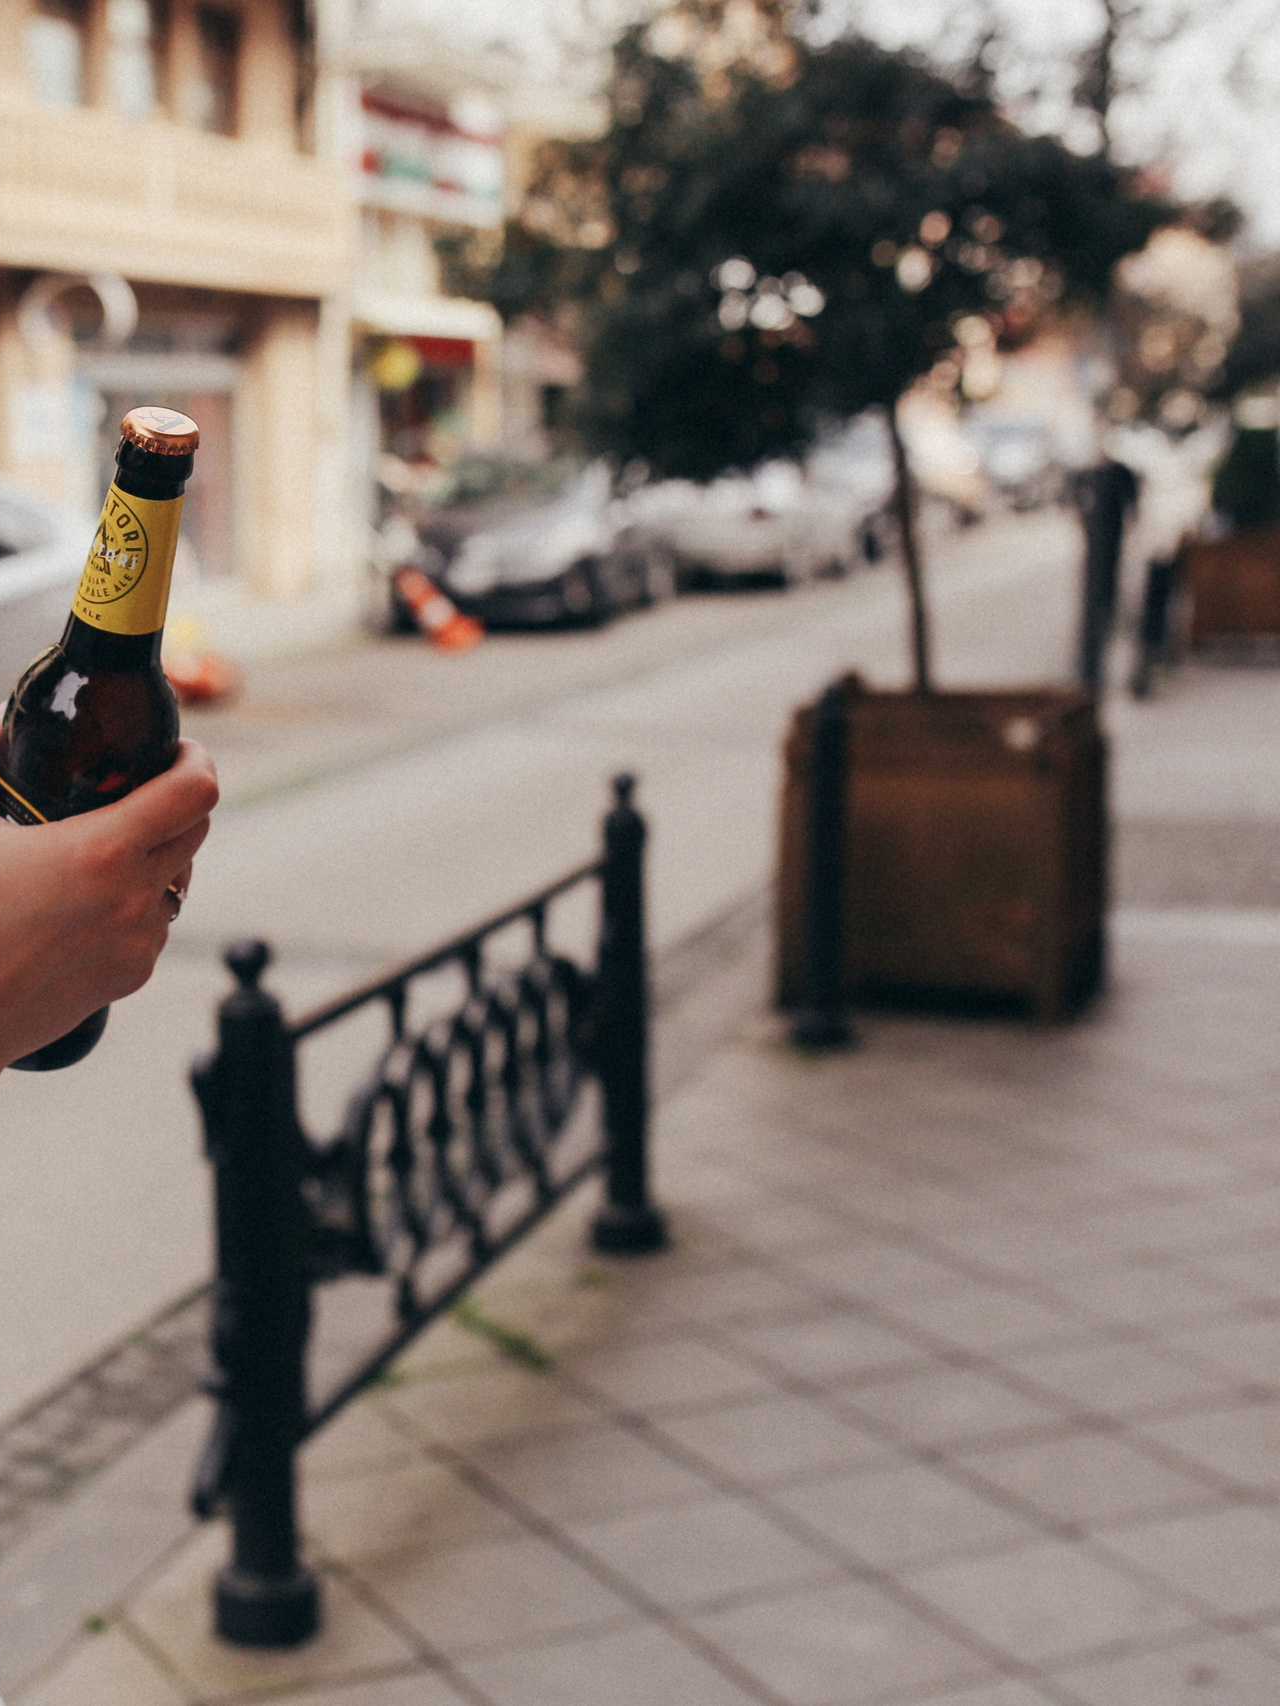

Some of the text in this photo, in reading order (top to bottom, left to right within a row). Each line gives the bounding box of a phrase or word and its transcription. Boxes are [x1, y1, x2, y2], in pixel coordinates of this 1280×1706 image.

[86, 573, 133, 598] PALE ALE
[83, 607, 102, 621] ALE
